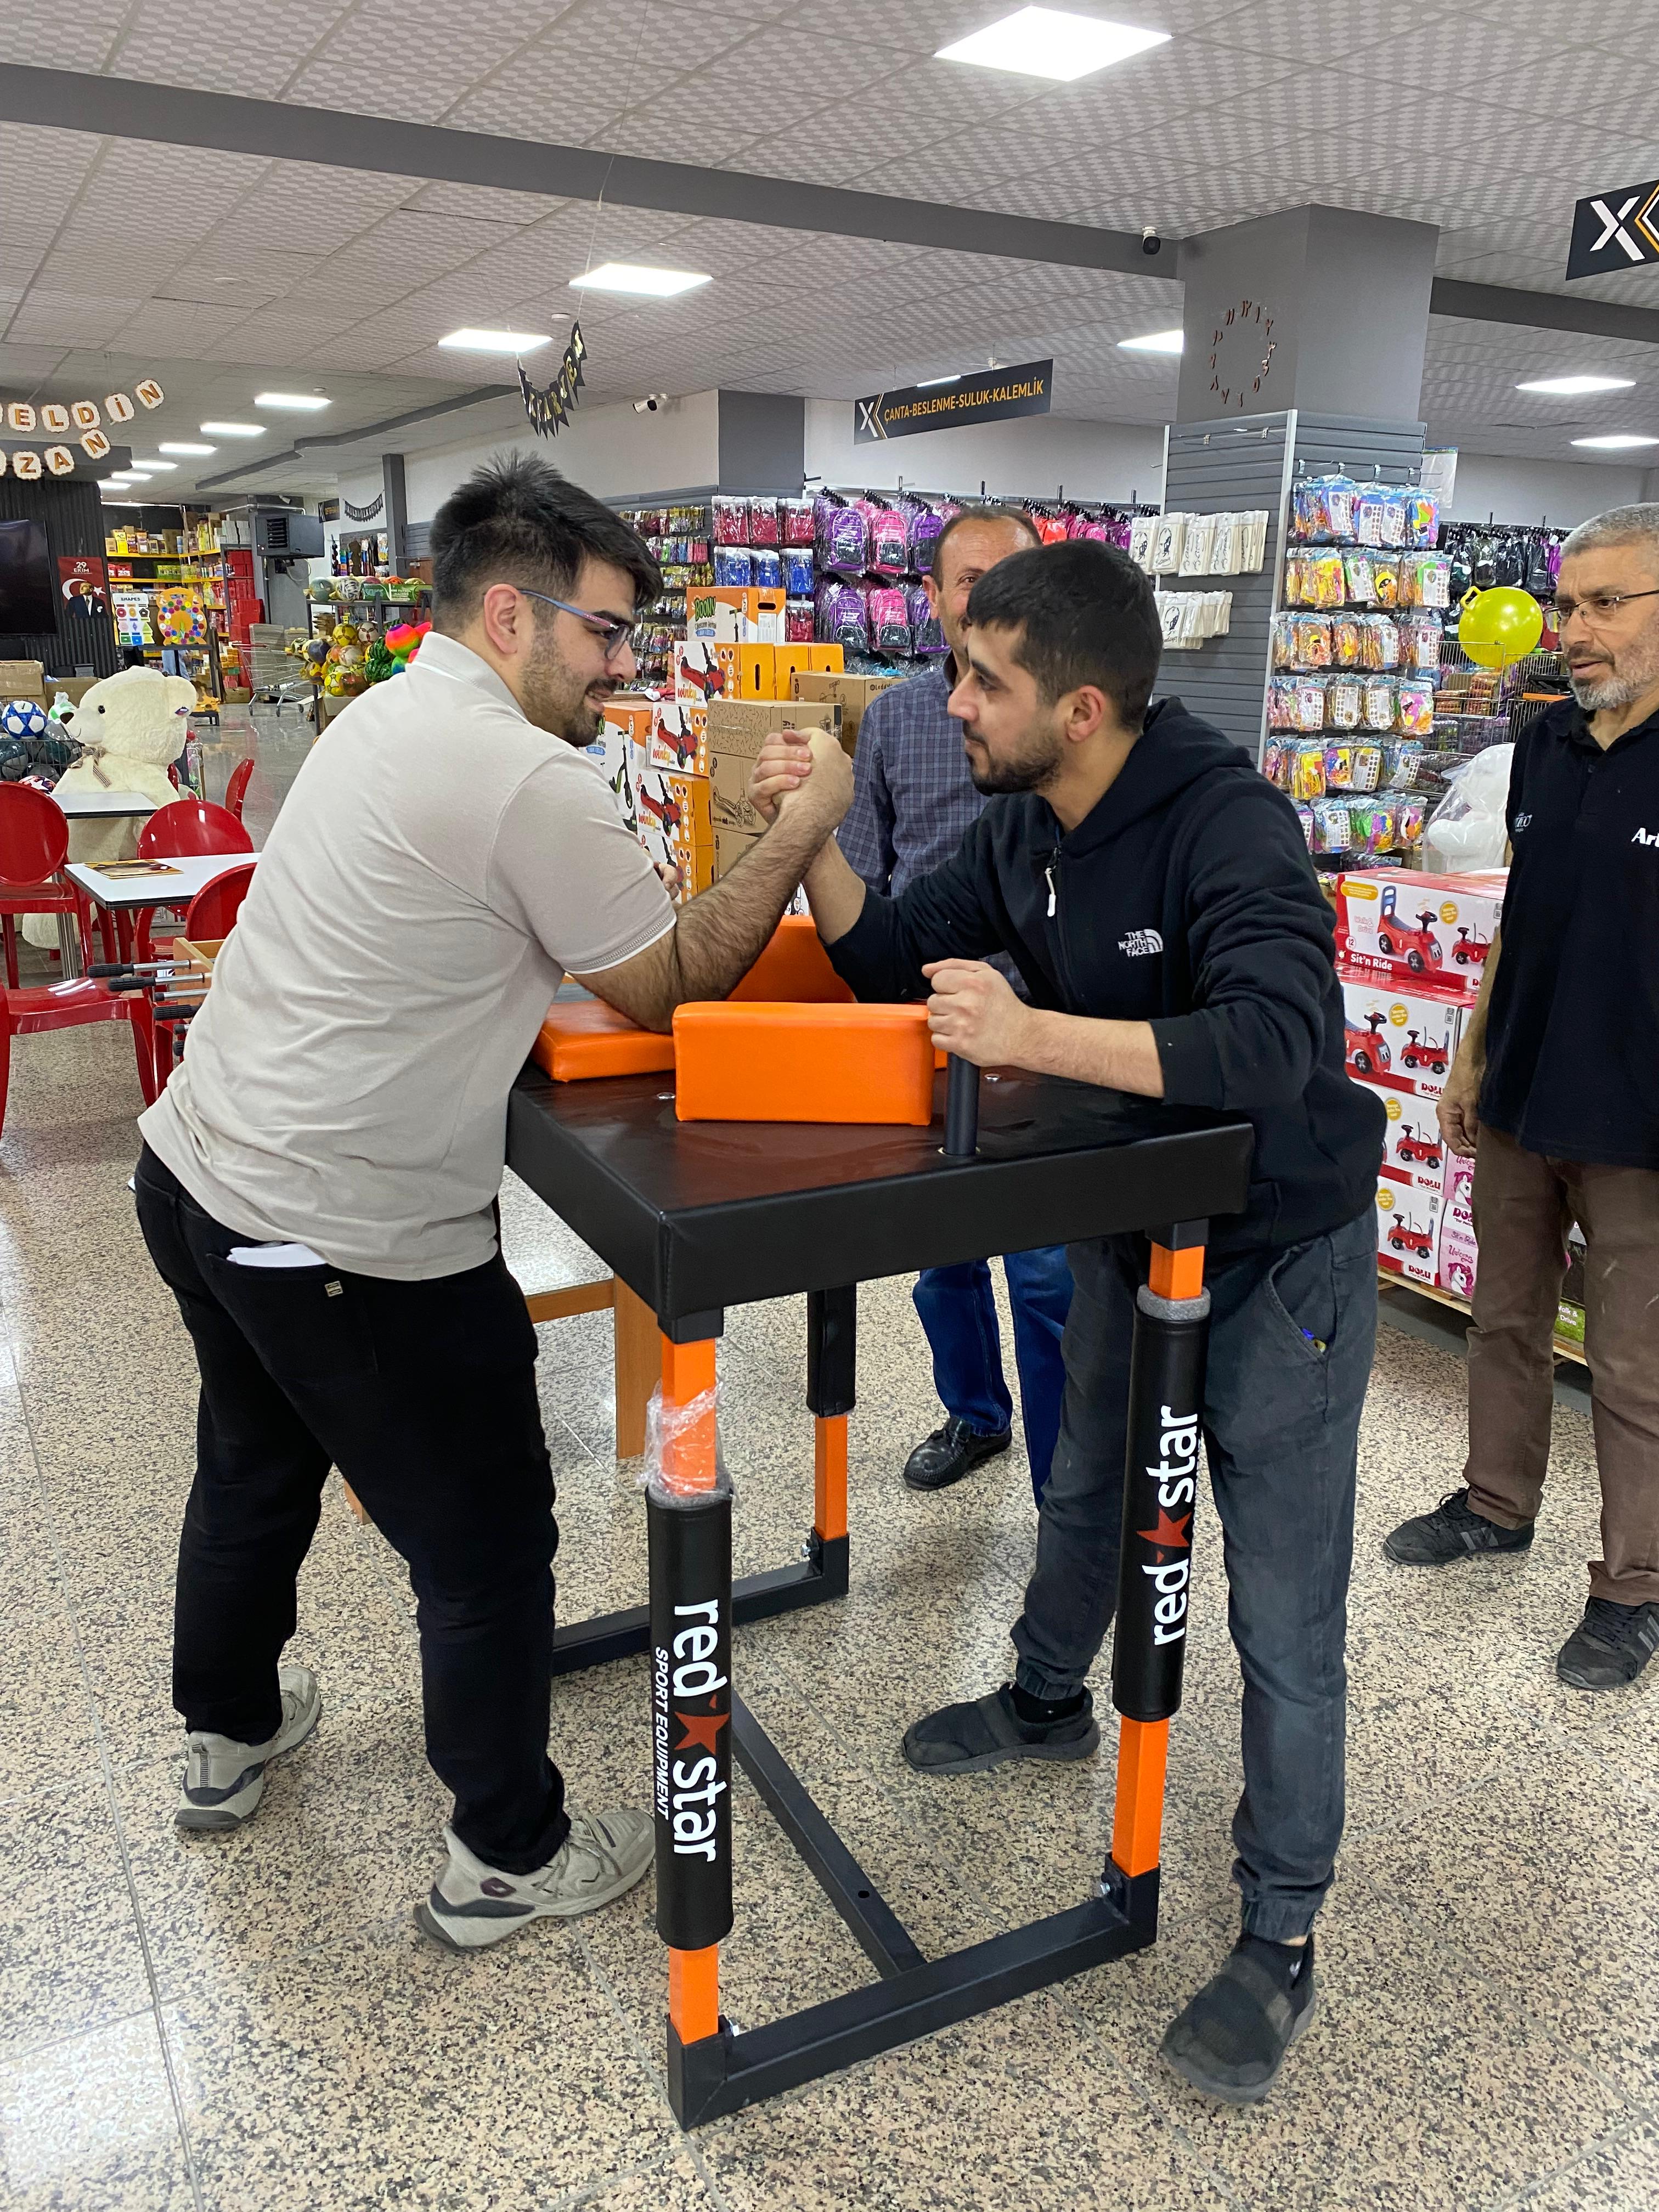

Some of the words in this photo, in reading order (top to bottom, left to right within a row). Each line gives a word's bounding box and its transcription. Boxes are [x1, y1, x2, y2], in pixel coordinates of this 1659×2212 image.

[15, 383, 161, 426] ELDİN
[884, 377, 1045, 425] ÇANTA-BESLENME-SULUK-KALEMLİK
[19, 433, 106, 473] ZAN
[695, 596, 716, 622] BOONY
[1118, 938, 1148, 951] NORTH
[1125, 930, 1146, 940] THE
[1126, 946, 1150, 957] FACE
[1348, 938, 1355, 946] 12
[1373, 958, 1393, 970] Ride
[1418, 1176, 1441, 1190] DOLU
[1408, 1265, 1431, 1279] DOLU
[1146, 1405, 1198, 1508] star
[1142, 1558, 1189, 1646] red
[673, 1599, 727, 1697] red
[656, 1646, 668, 1711] SPORT
[656, 1712, 669, 1821] EQUIPMENT
[673, 1756, 727, 1863] star
